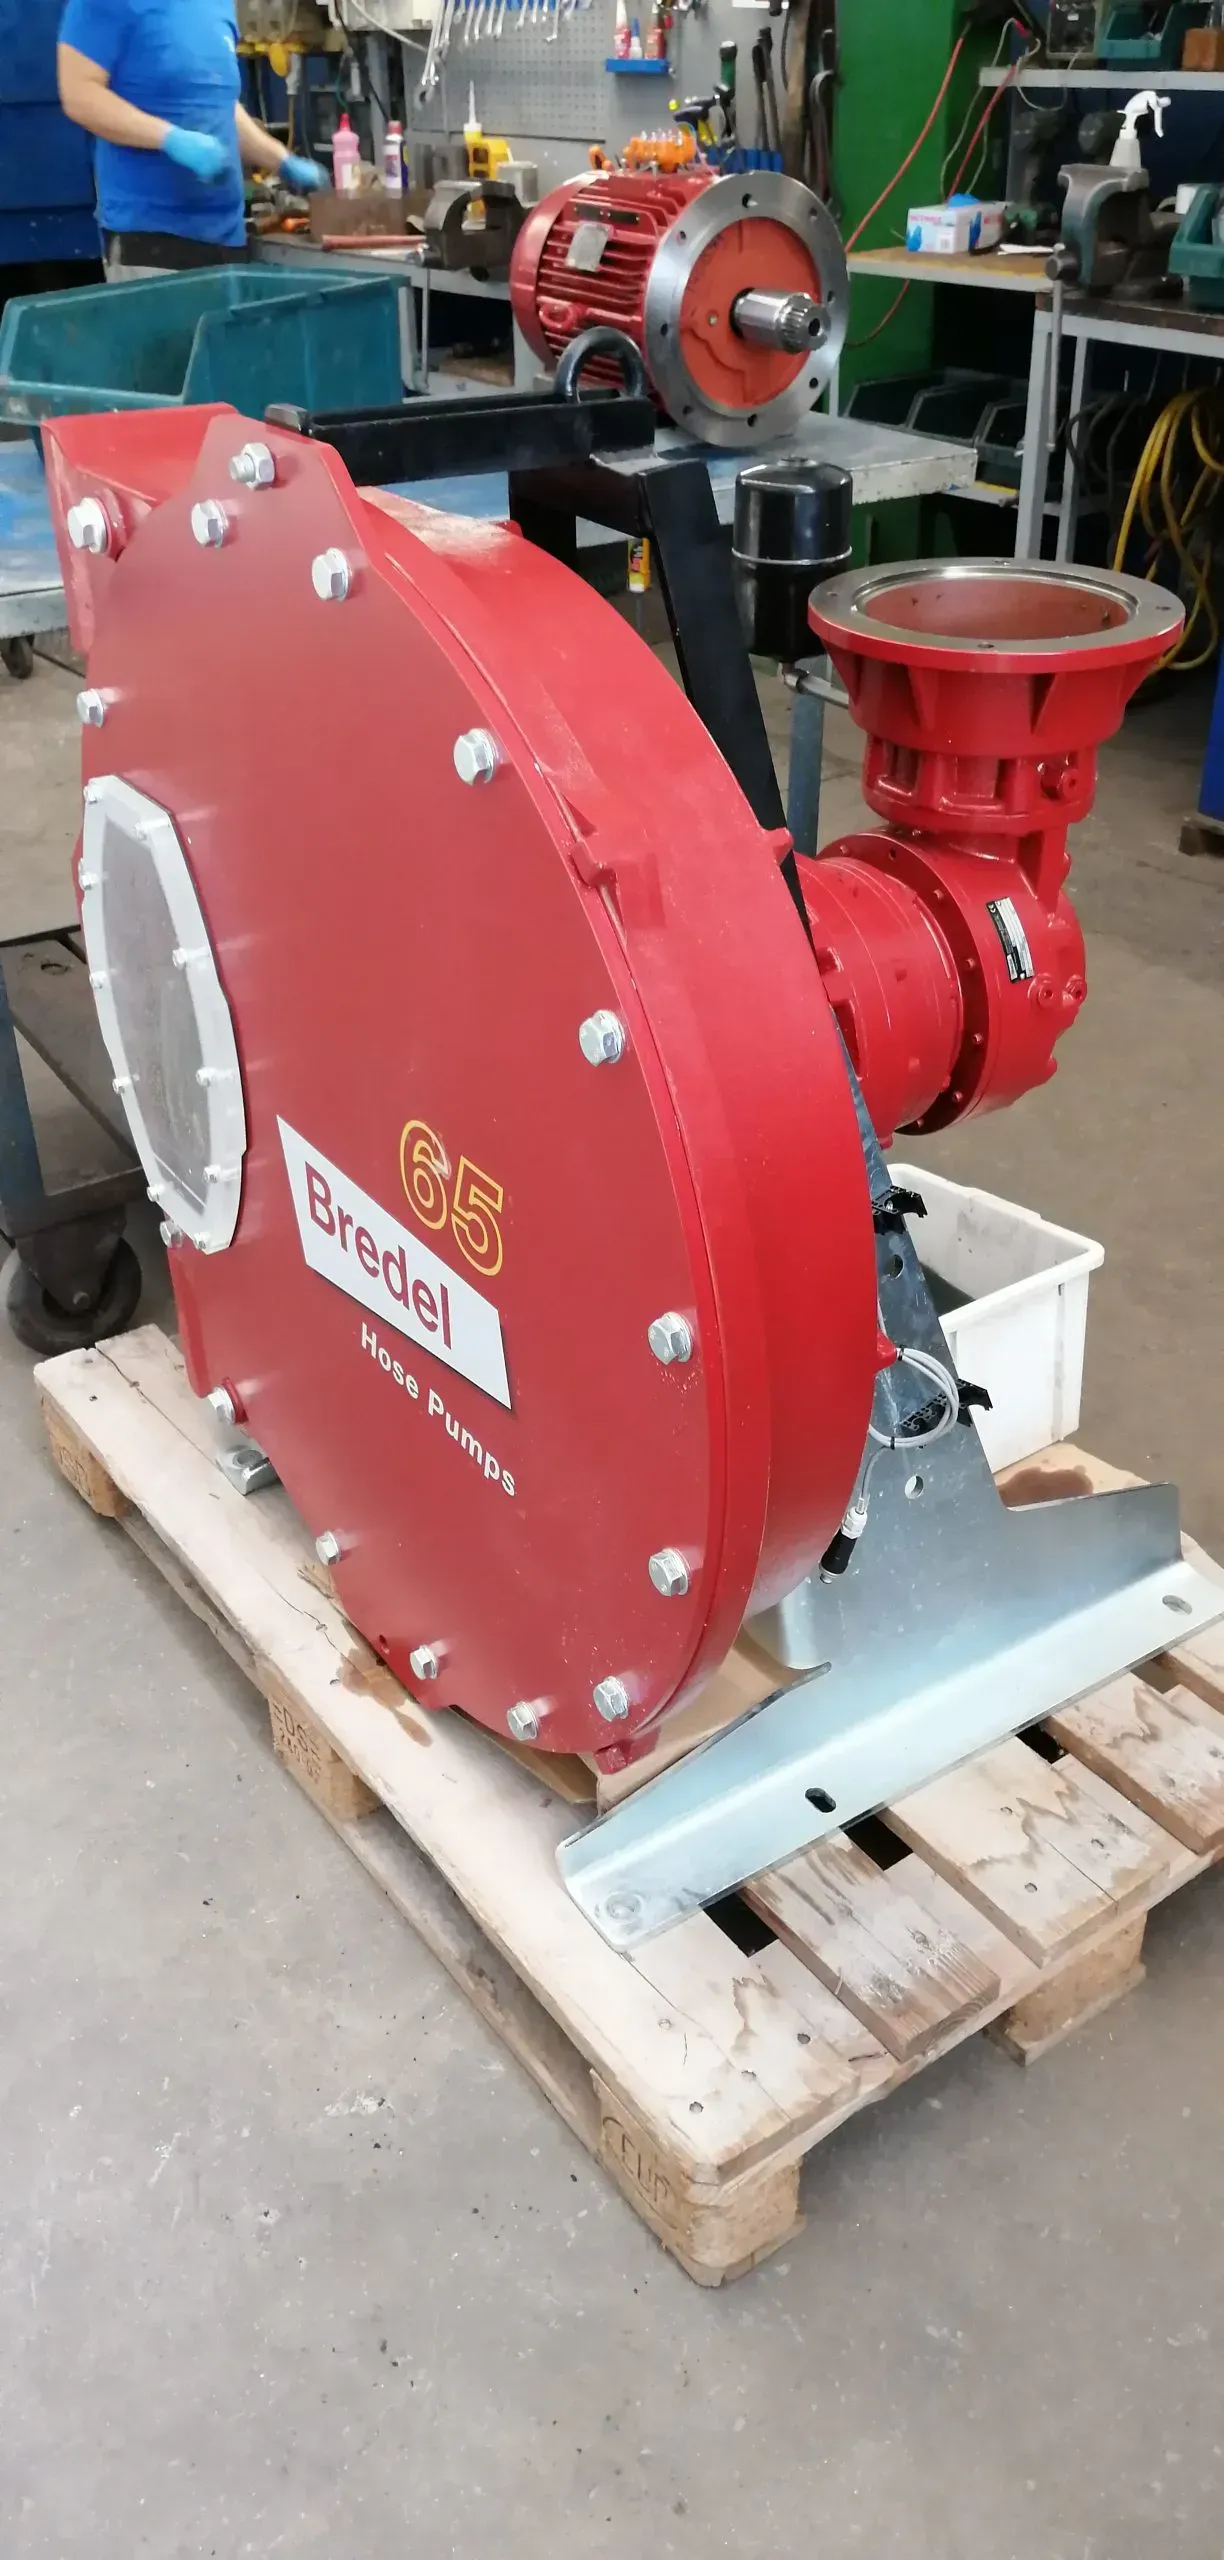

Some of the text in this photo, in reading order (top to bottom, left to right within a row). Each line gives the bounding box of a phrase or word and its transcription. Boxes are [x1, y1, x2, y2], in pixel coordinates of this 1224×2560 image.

[304, 1161, 453, 1350] Bredel
[400, 1119, 504, 1277] 65
[361, 1322, 517, 1497] Hose Pumps
